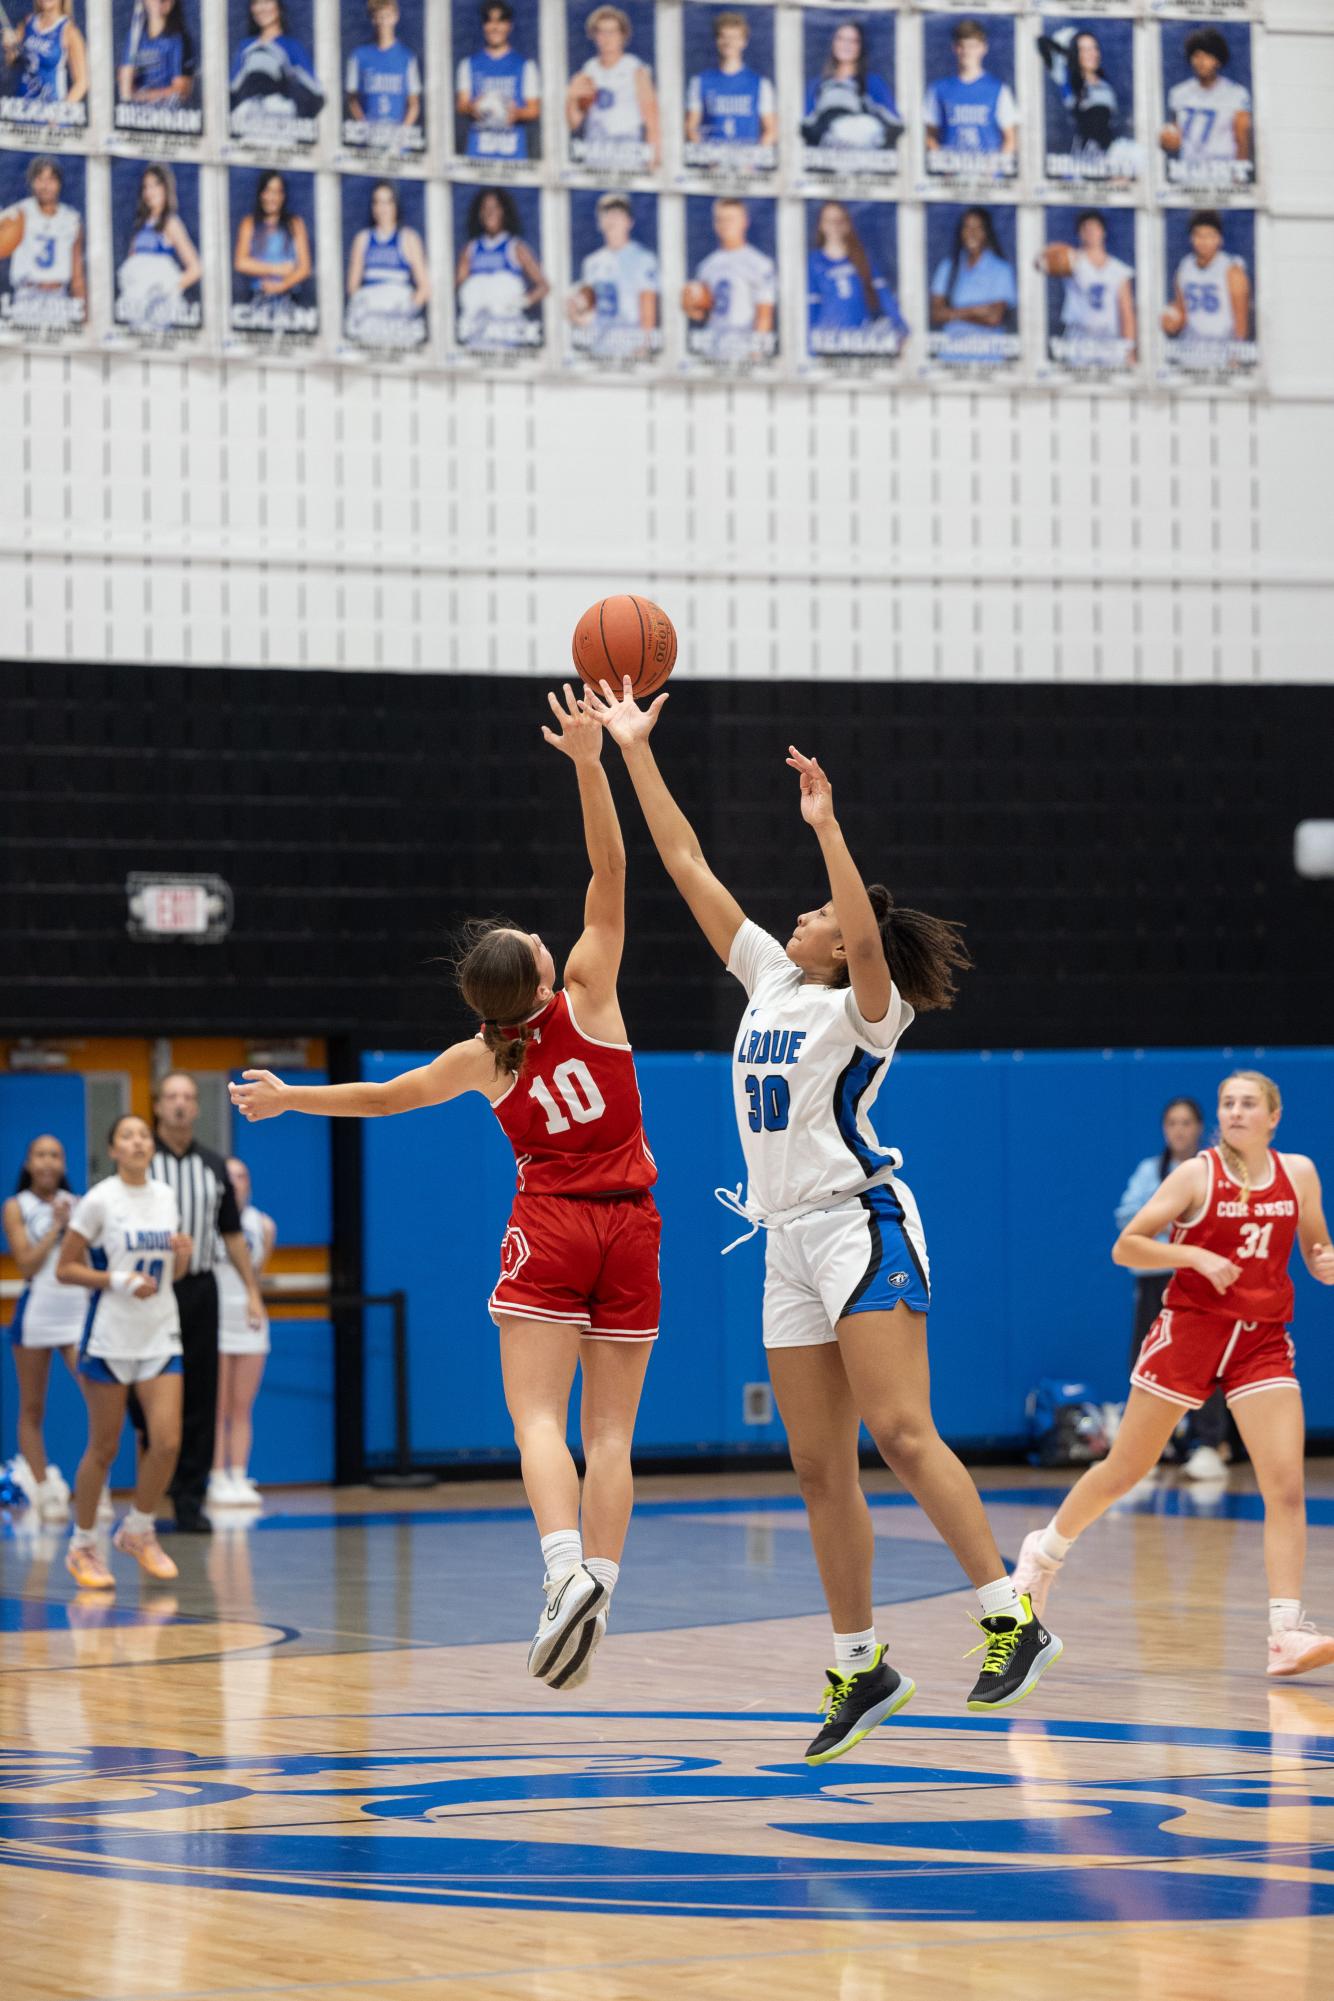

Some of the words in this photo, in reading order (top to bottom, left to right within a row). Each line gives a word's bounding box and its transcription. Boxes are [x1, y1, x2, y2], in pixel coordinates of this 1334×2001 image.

[528, 1058, 606, 1135] 10
[745, 1074, 790, 1133] 30
[1236, 1222, 1274, 1259] 31
